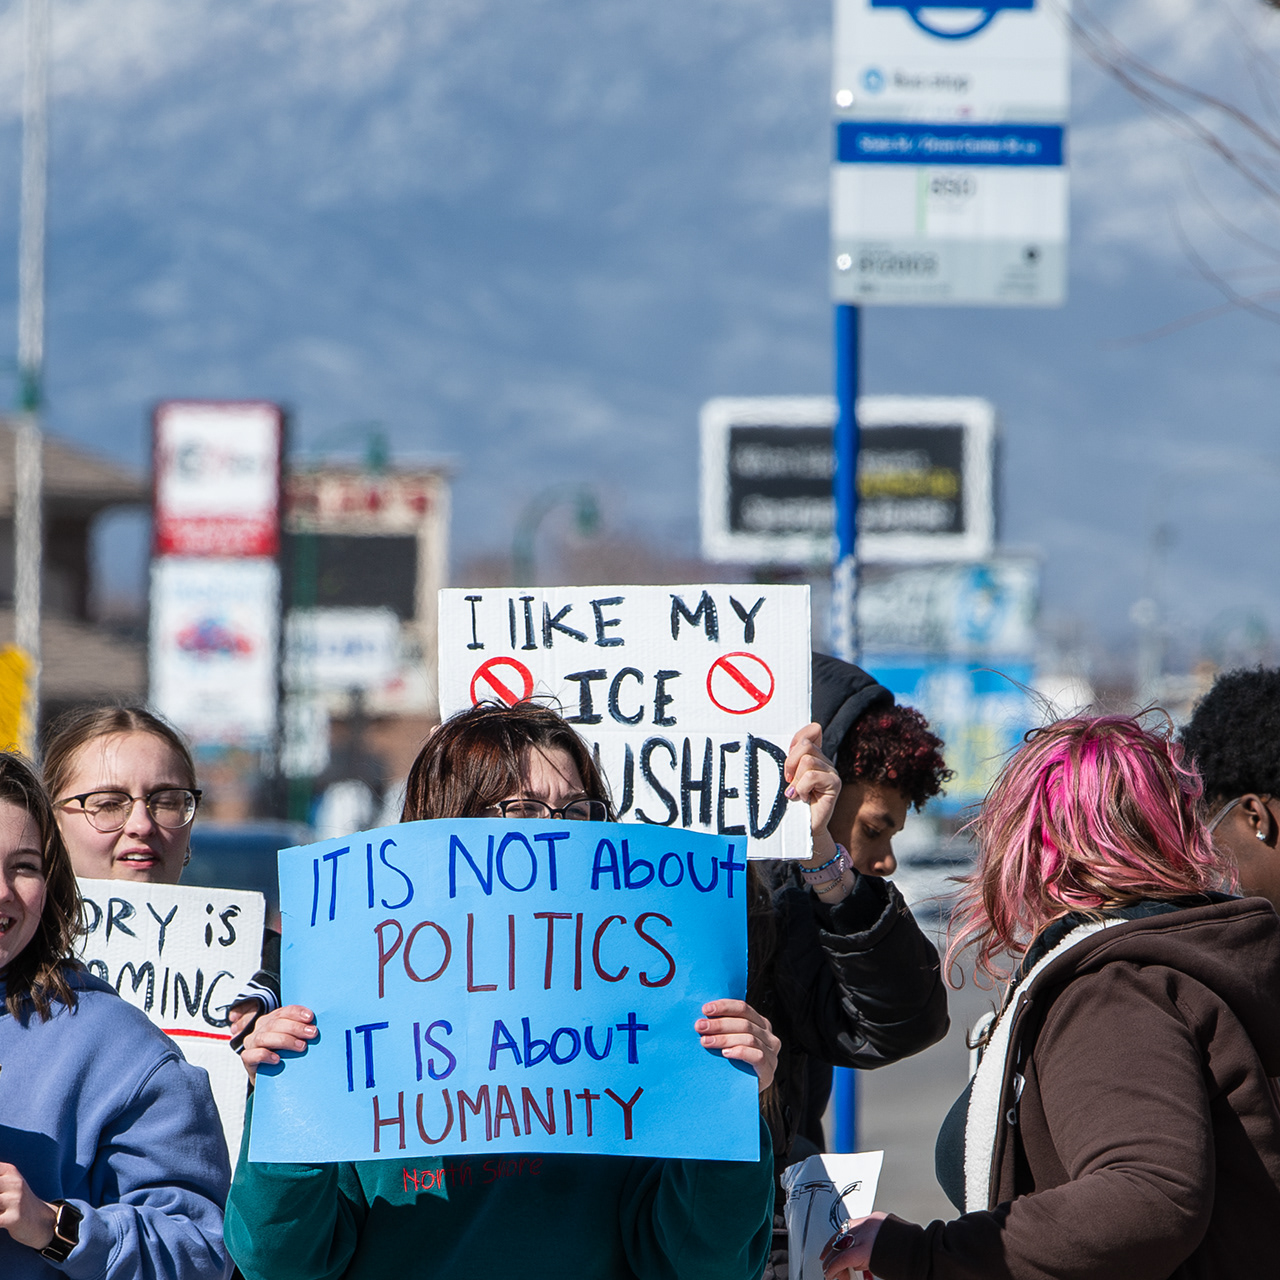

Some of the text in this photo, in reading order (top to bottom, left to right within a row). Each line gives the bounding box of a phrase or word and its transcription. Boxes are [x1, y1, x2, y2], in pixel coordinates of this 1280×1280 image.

[464, 594, 485, 650] I
[669, 589, 767, 645] MY
[563, 666, 682, 727] ICE
[310, 831, 747, 927] IT IS NOT About
[205, 902, 242, 947] is
[373, 911, 677, 1000] POLITICS
[345, 1011, 650, 1093] IT IS About
[372, 1084, 644, 1154] HUMANITY
[402, 1155, 543, 1193] North Shore
